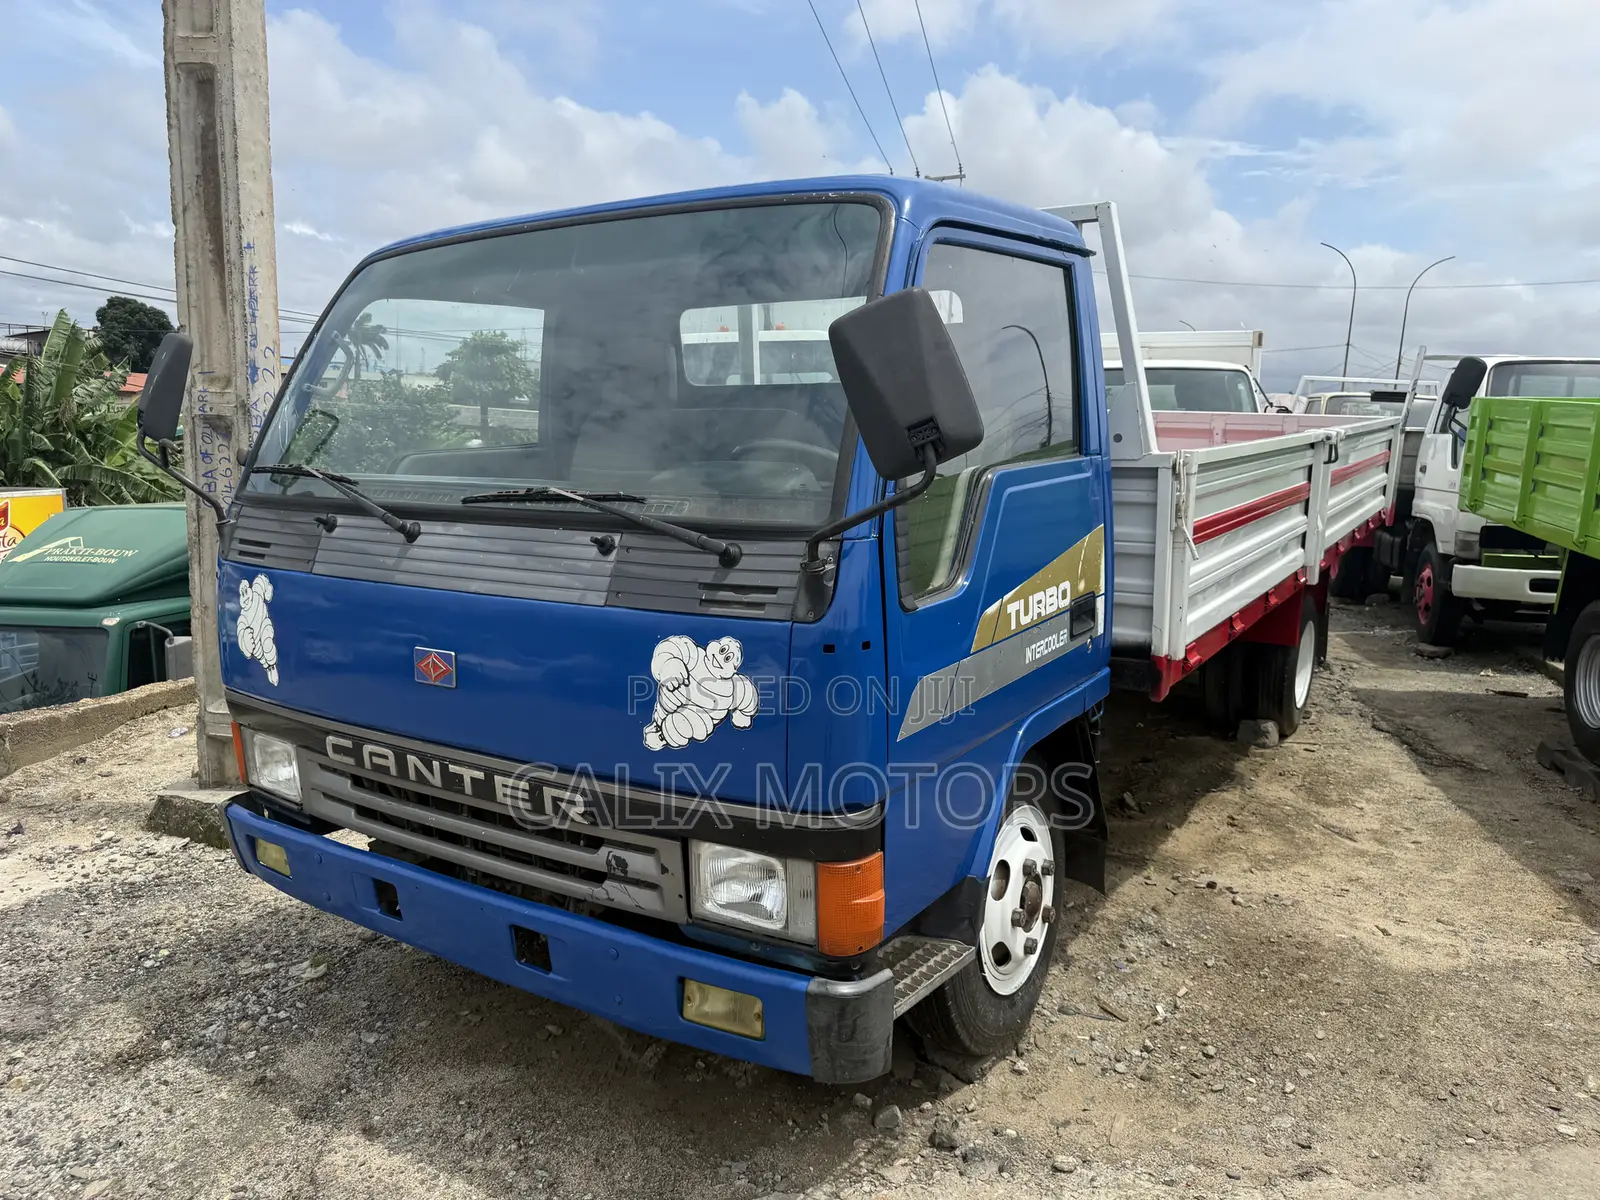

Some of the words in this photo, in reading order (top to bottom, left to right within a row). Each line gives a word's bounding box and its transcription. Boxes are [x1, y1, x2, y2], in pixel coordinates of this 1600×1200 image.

[262, 340, 275, 417] 222
[1006, 580, 1071, 631] TURBO
[1025, 628, 1068, 664] INTERCOOLER
[325, 735, 591, 825] CANTER
